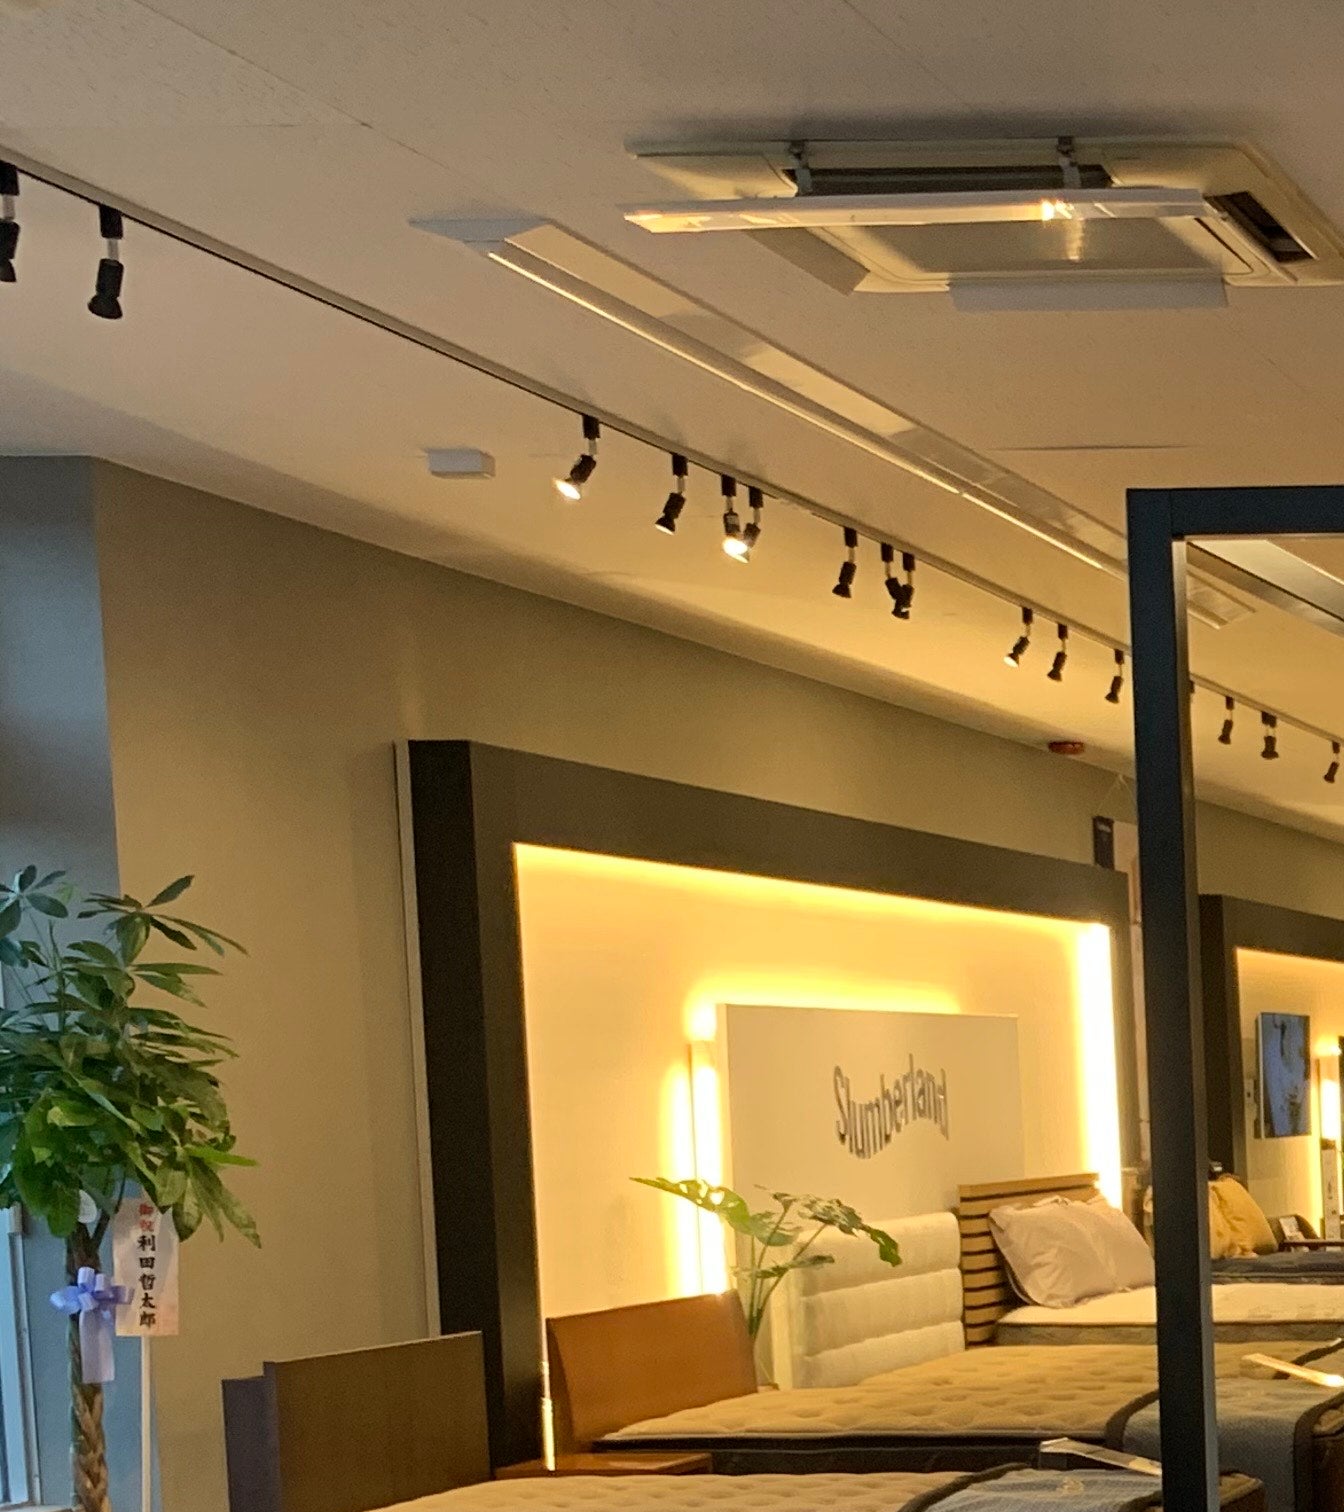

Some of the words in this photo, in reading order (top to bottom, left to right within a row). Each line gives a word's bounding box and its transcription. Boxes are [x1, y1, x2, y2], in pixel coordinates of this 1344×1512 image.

[833, 1065, 949, 1159] Slumberland
[137, 1235, 156, 1329] 利田哲太郎
